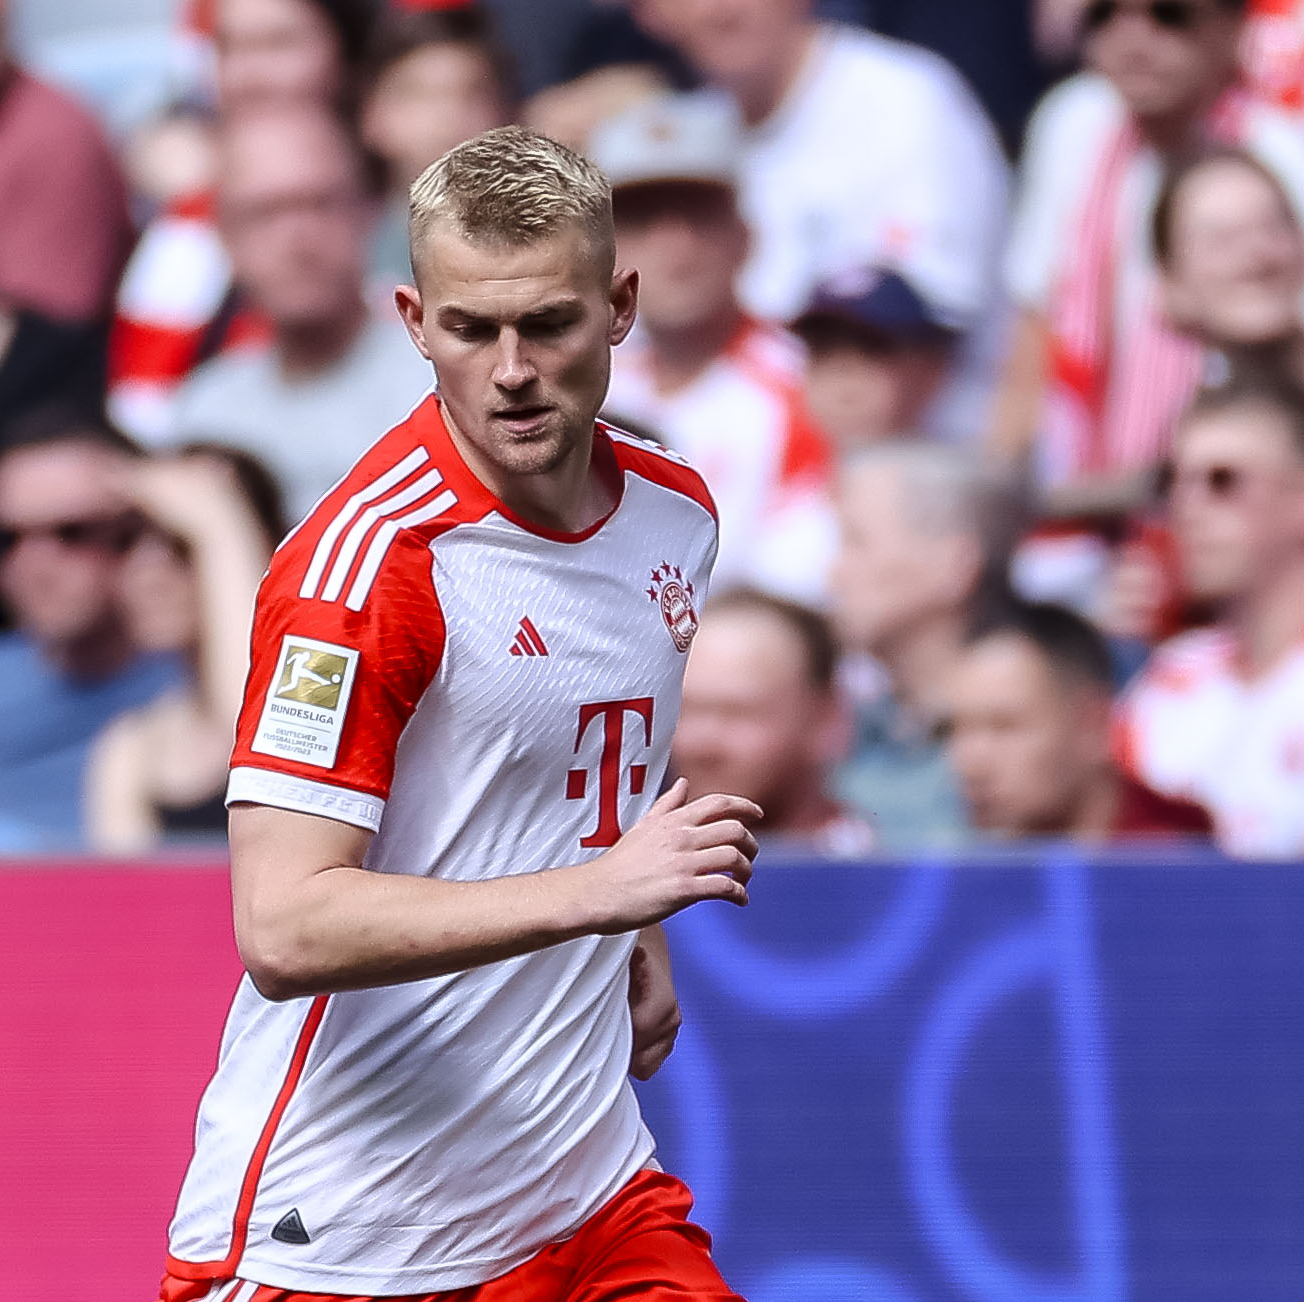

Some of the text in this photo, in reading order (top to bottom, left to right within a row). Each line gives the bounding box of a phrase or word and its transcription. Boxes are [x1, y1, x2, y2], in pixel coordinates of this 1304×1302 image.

[270, 703, 334, 725] BUNDESLIGA
[263, 732, 329, 752] FUSSBALLMEISTER
[275, 727, 318, 742] DEUTSCHER
[564, 696, 655, 849] T
